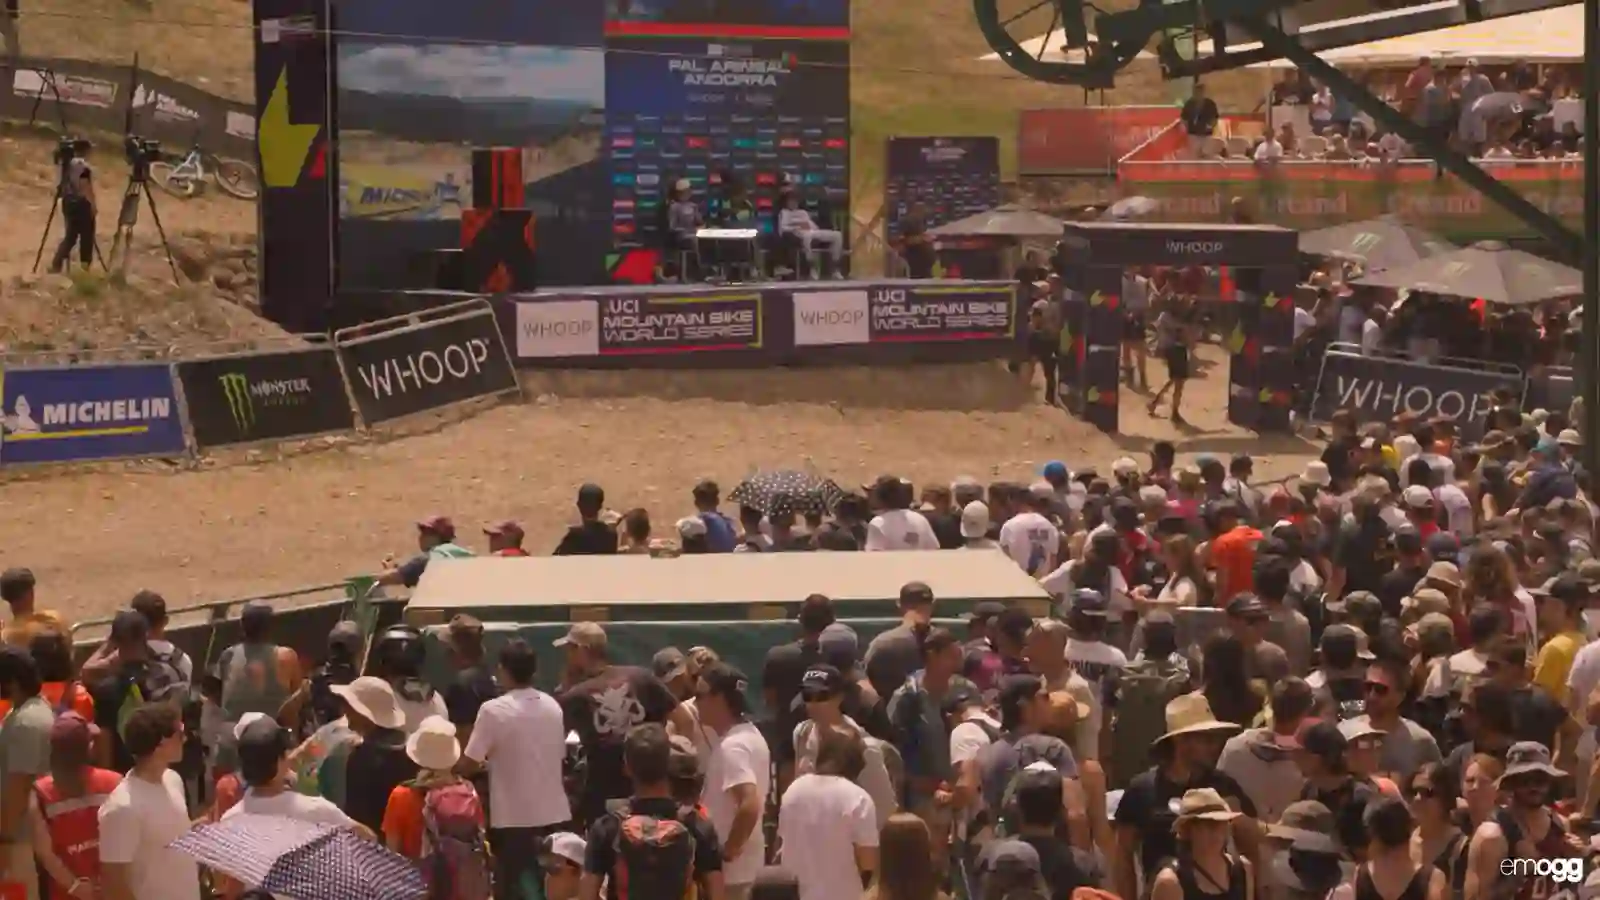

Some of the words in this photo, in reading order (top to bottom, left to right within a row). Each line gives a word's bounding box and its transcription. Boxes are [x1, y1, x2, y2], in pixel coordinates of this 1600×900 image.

[683, 73, 777, 87] ANDORRA
[1166, 238, 1224, 253] WHOOP
[800, 310, 865, 326] WHOOP
[873, 303, 965, 317] MOUNTAIN
[968, 301, 1008, 314] BIKE
[603, 313, 705, 328] MOUNTAIN
[709, 310, 754, 324] BIKE
[873, 316, 941, 330] WORLD
[945, 314, 1008, 328] SERIES
[523, 319, 594, 339] WHOOP
[603, 326, 679, 342] WORLD
[683, 324, 754, 339] SERIES
[358, 338, 488, 400] WHOOP
[250, 377, 312, 397] MONSTER
[43, 397, 171, 426] MICHELIN
